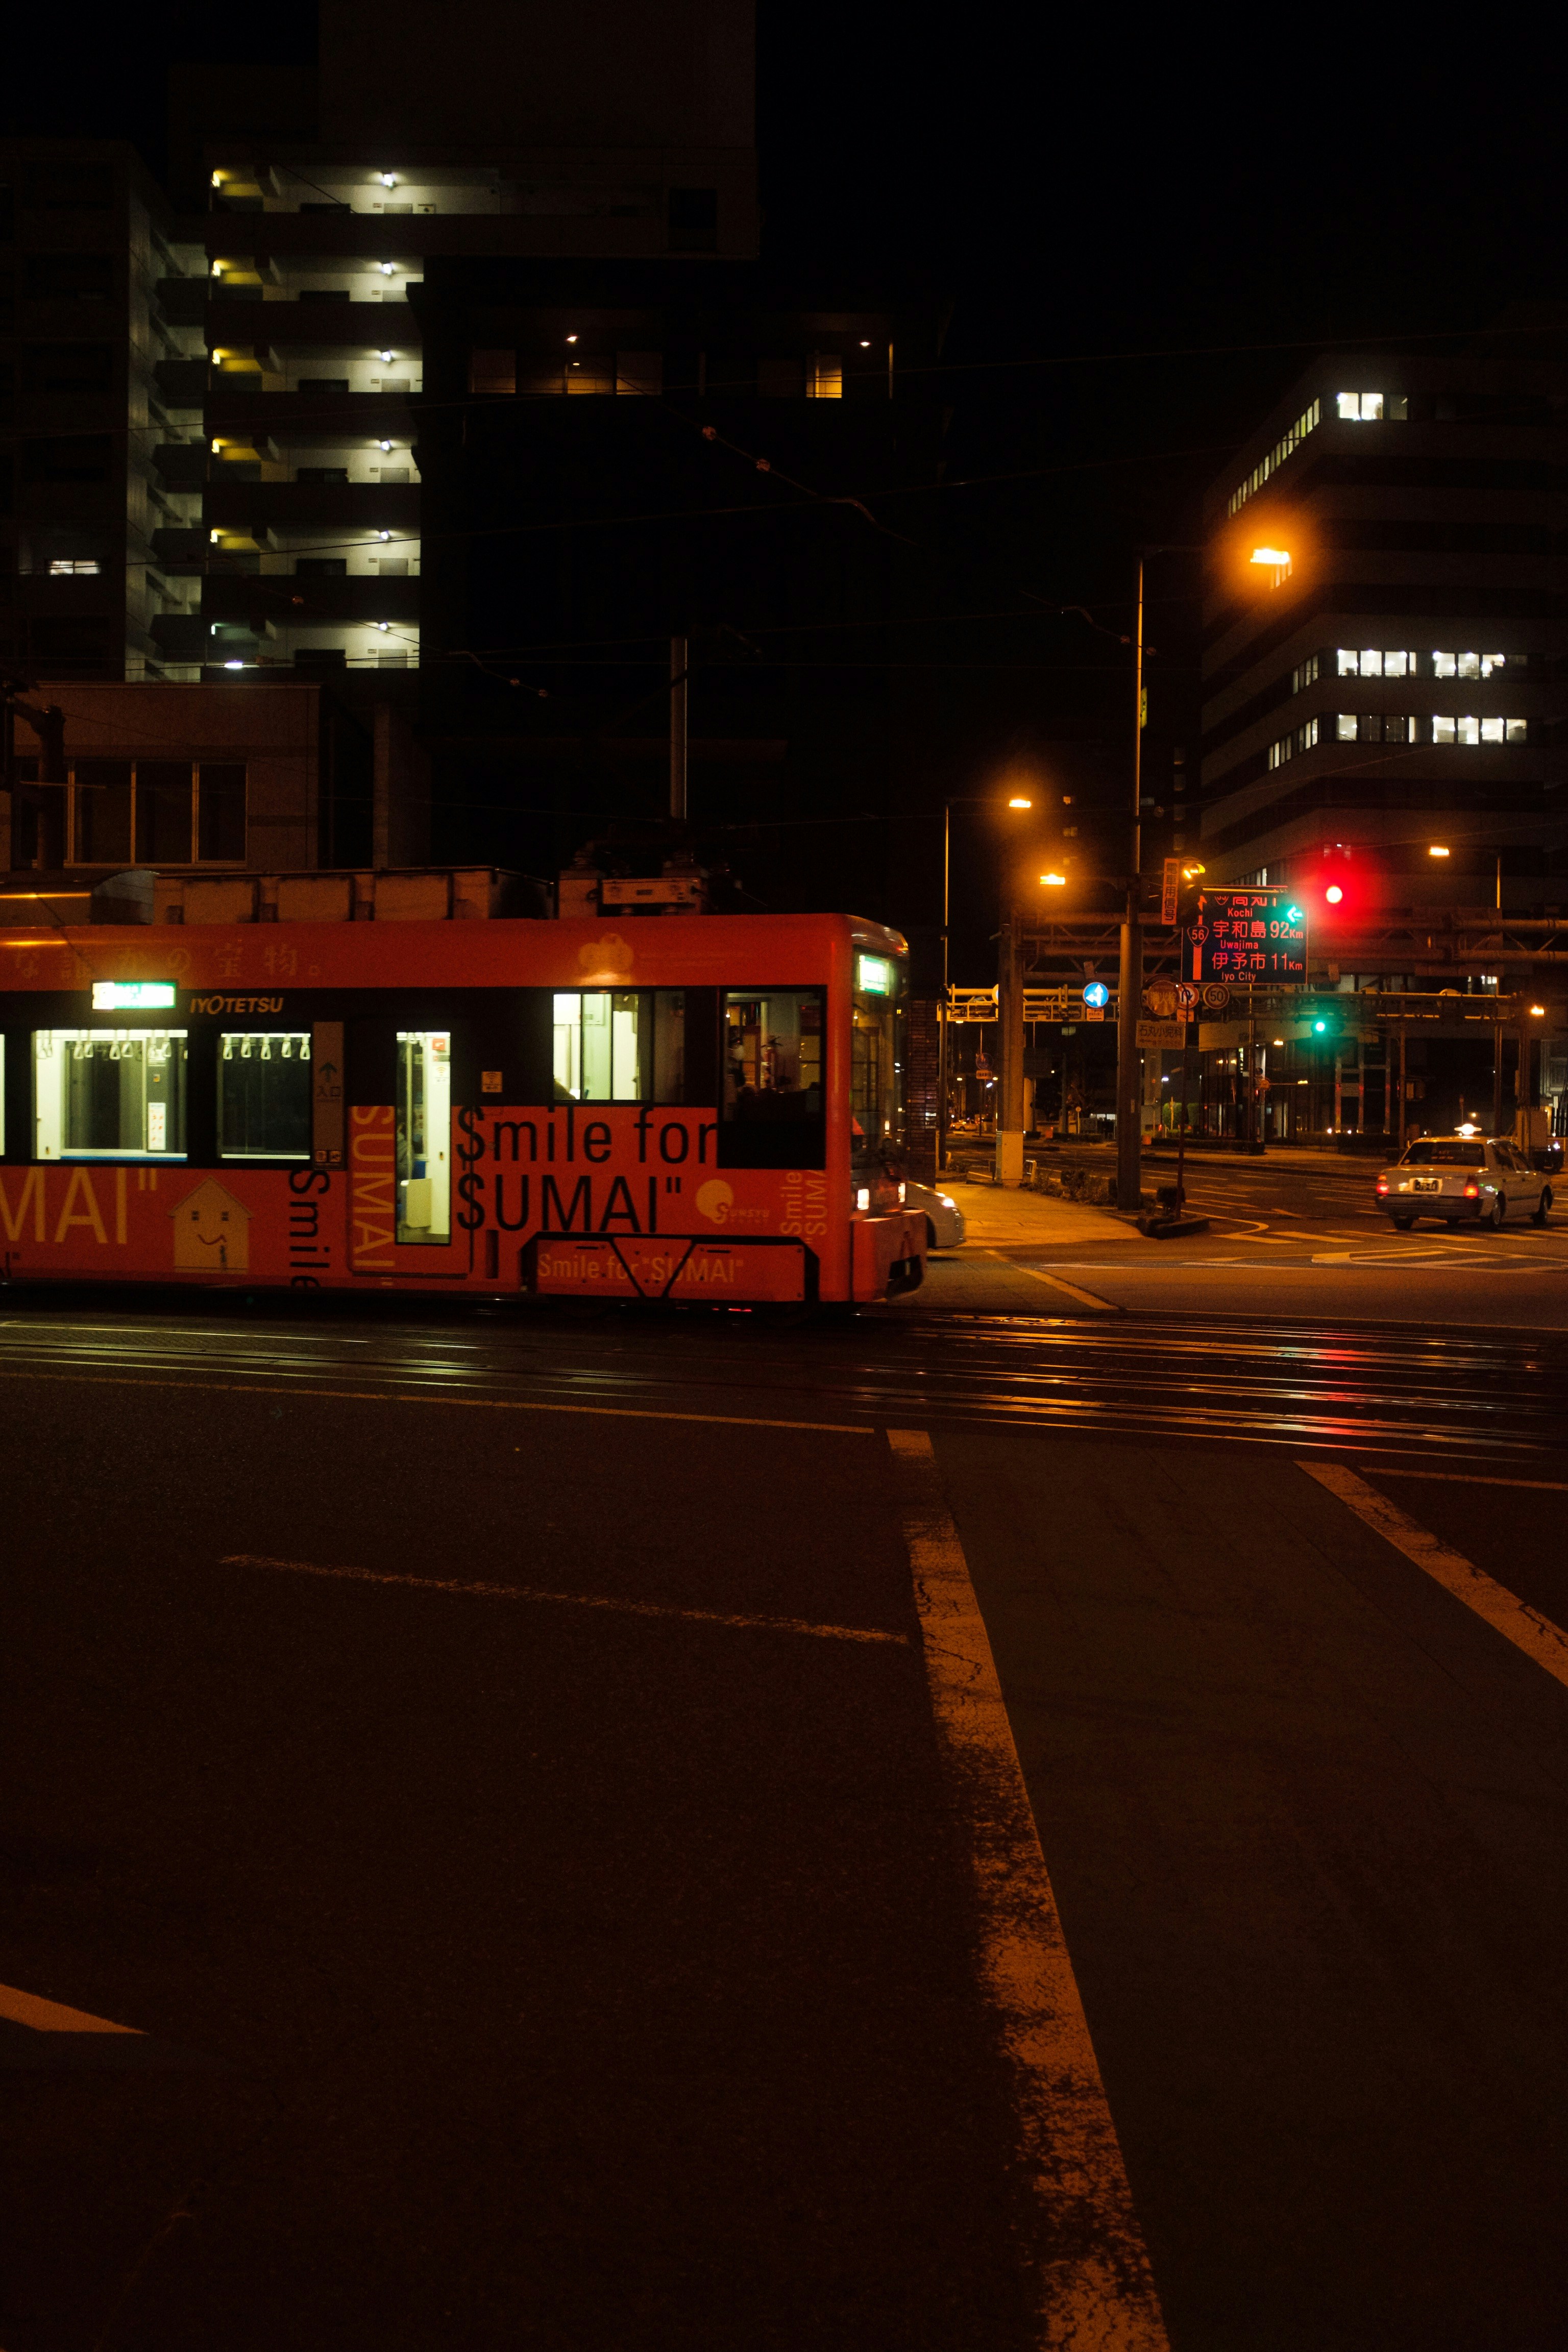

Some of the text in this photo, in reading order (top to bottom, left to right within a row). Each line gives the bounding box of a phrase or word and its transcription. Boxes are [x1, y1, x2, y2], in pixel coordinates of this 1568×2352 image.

[1165, 863, 1177, 920] 電車用信号
[1228, 908, 1253, 917] Kochi
[1191, 929, 1205, 940] 56
[1213, 920, 1266, 938] 宇和島
[1220, 940, 1259, 951] Uwajima
[1212, 952, 1266, 970] 伊予市
[1221, 971, 1256, 982] Iyo City
[189, 995, 284, 1015] IYOTETSU
[1210, 991, 1223, 1001] 50
[317, 1086, 341, 1097] 入口
[457, 1104, 718, 1164] Smile for
[779, 1172, 803, 1235] Smile
[537, 1254, 600, 1279] Smile
